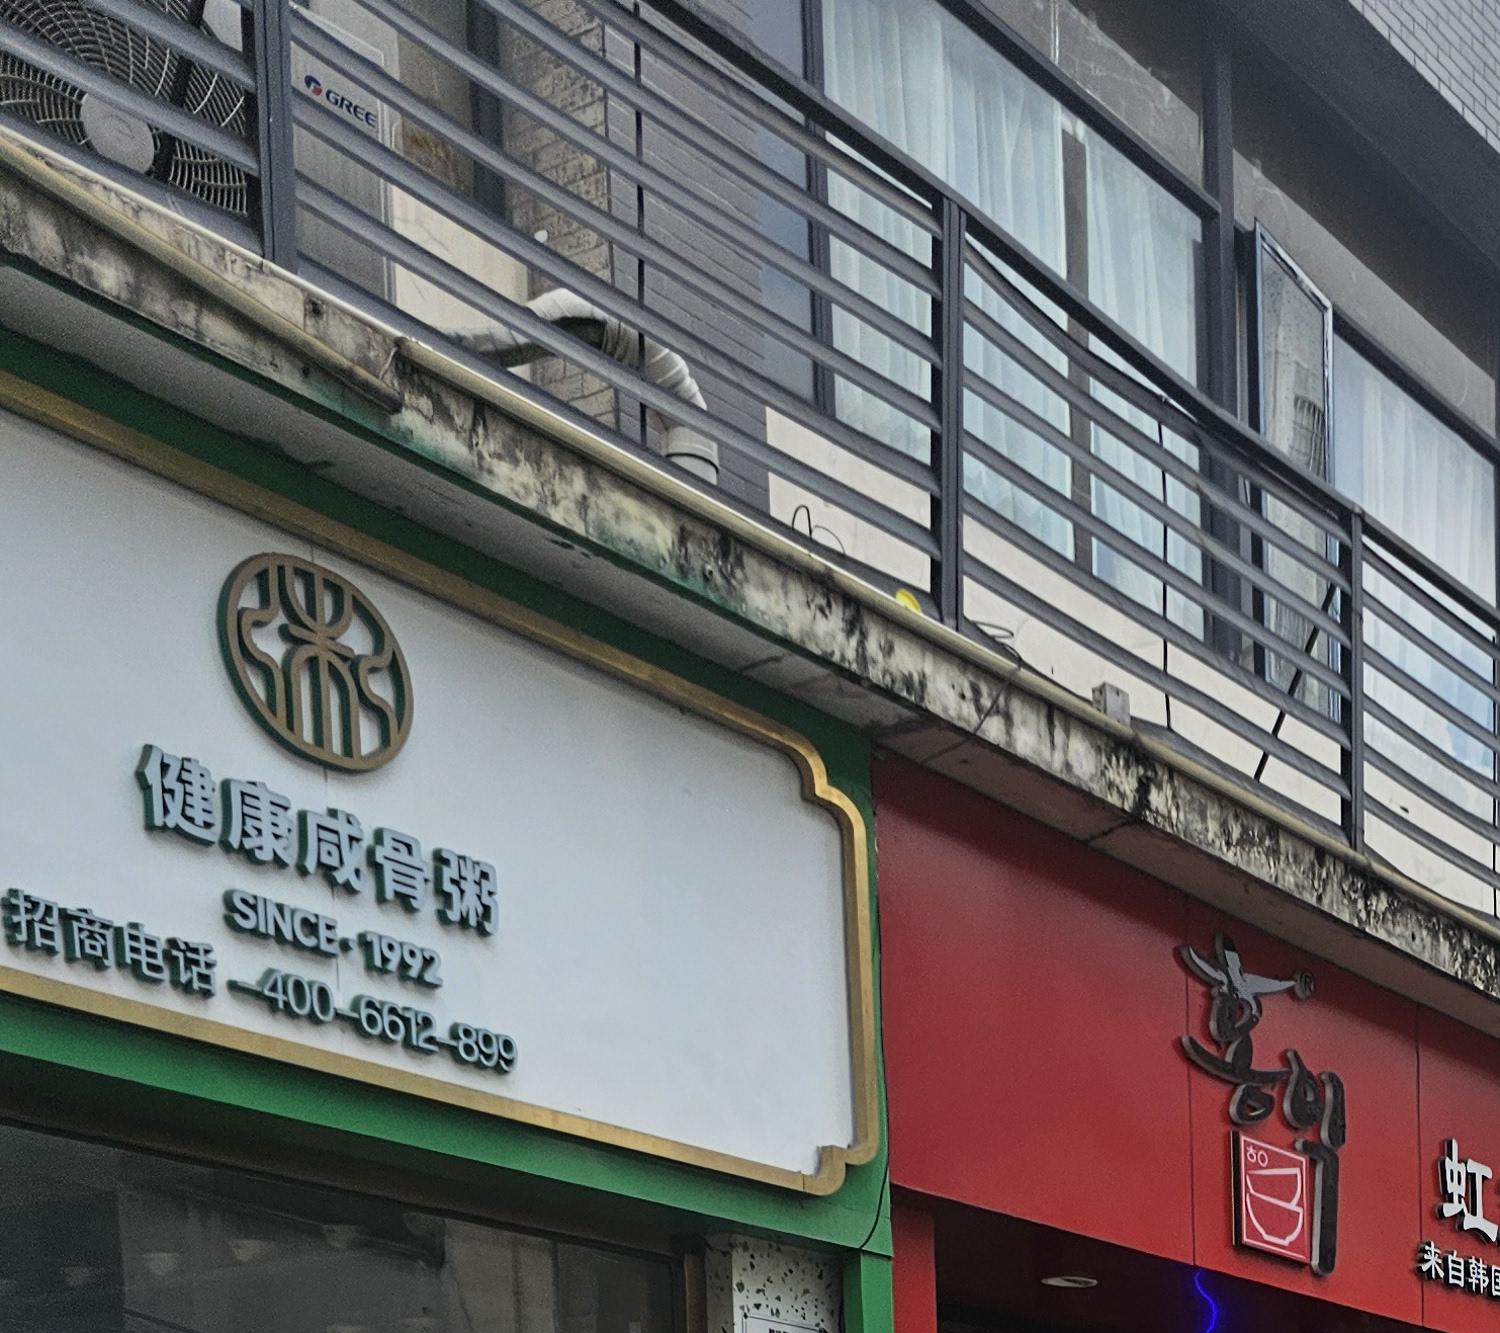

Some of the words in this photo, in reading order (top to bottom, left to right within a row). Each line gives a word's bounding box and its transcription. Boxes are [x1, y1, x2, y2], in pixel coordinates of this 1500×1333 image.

[324, 88, 378, 128] GREE
[136, 744, 500, 936] 健康咸骨粥
